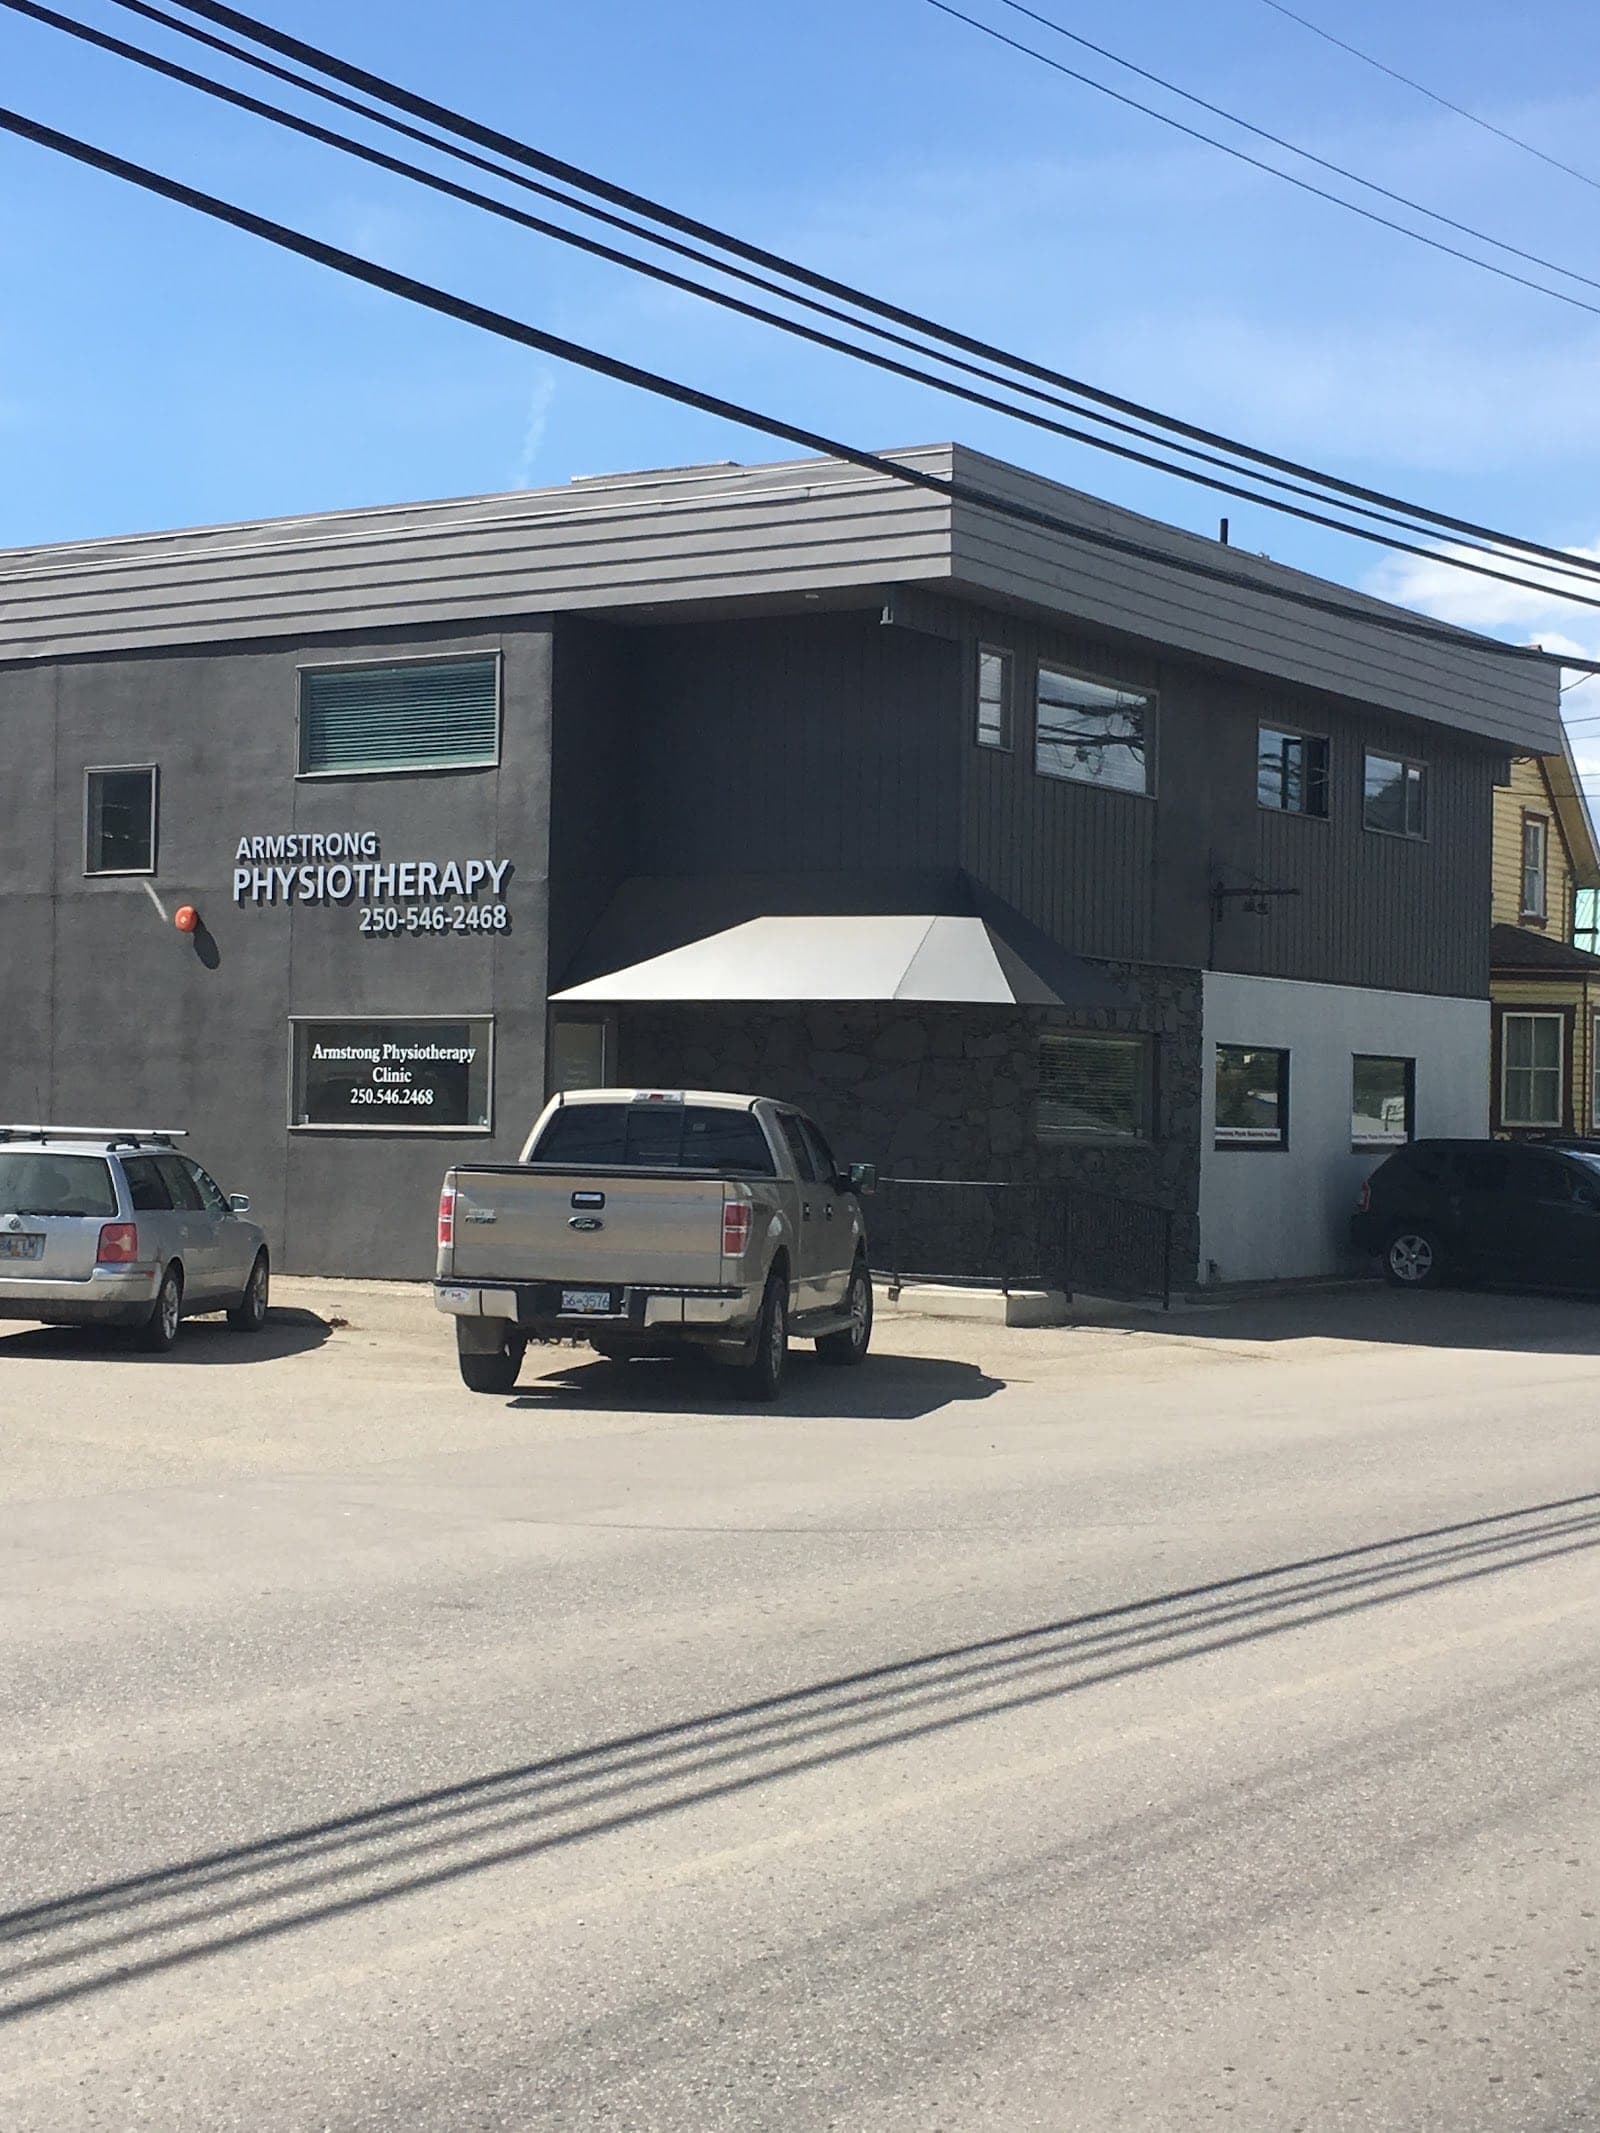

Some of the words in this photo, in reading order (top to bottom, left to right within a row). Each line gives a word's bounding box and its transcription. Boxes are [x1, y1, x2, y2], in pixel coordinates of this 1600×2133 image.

[235, 831, 377, 860] ARMSTRONG
[233, 859, 510, 902] PHYSIOTHERAPY
[359, 905, 507, 931] 250-546-2468
[312, 1043, 380, 1063] Armstrong
[382, 1043, 476, 1064] Physiotherapy
[372, 1066, 413, 1083] Clinic
[350, 1088, 434, 1105] 250.546.2468
